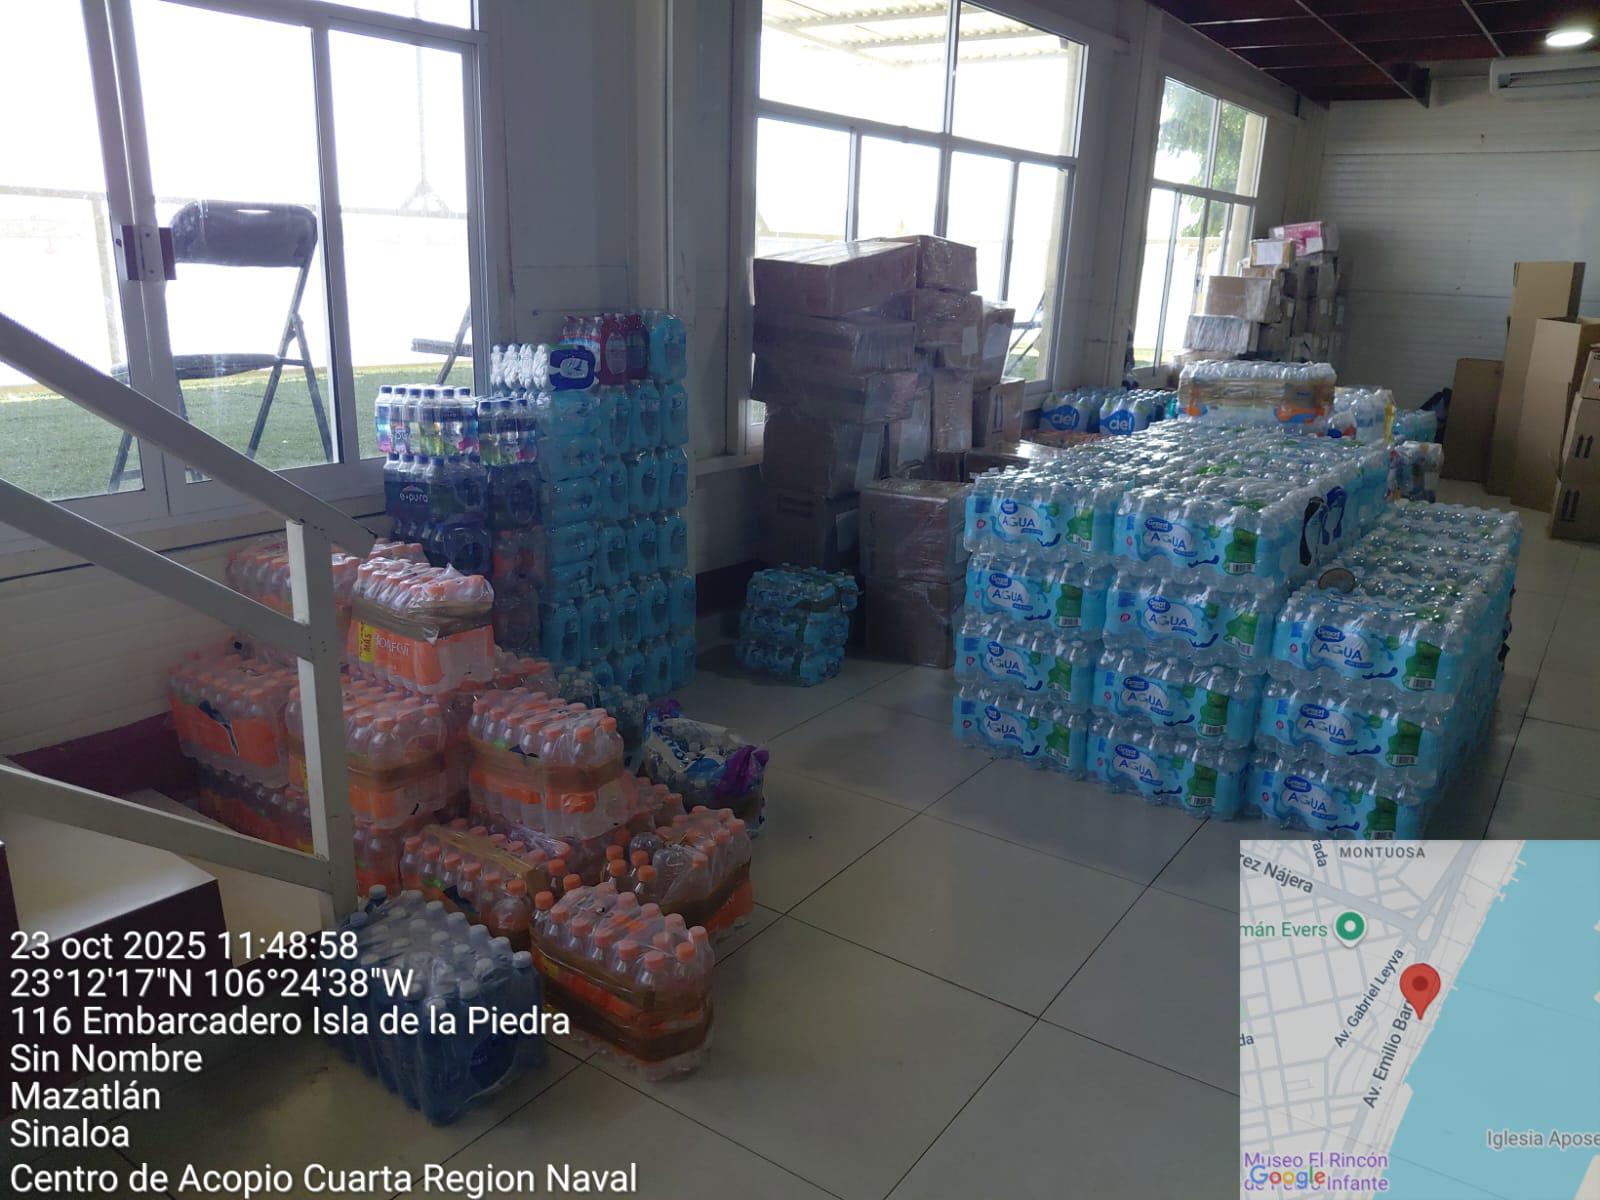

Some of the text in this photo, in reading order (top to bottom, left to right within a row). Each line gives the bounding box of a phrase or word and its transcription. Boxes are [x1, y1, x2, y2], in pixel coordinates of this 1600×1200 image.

[1051, 409, 1077, 427] ciel
[1108, 413, 1132, 431] ciel
[1002, 516, 1036, 528] AGUA
[1151, 532, 1186, 550] AGUA
[992, 589, 1024, 603] AGUA
[1149, 613, 1188, 627] AGUA
[1318, 642, 1362, 661] AGUA
[989, 656, 1020, 669] AGUA
[1127, 692, 1164, 708] AGUA
[987, 720, 1017, 734] AGUA
[1304, 719, 1345, 738] AGUA
[1119, 759, 1153, 778] AGUA
[1288, 792, 1327, 812] AGUA
